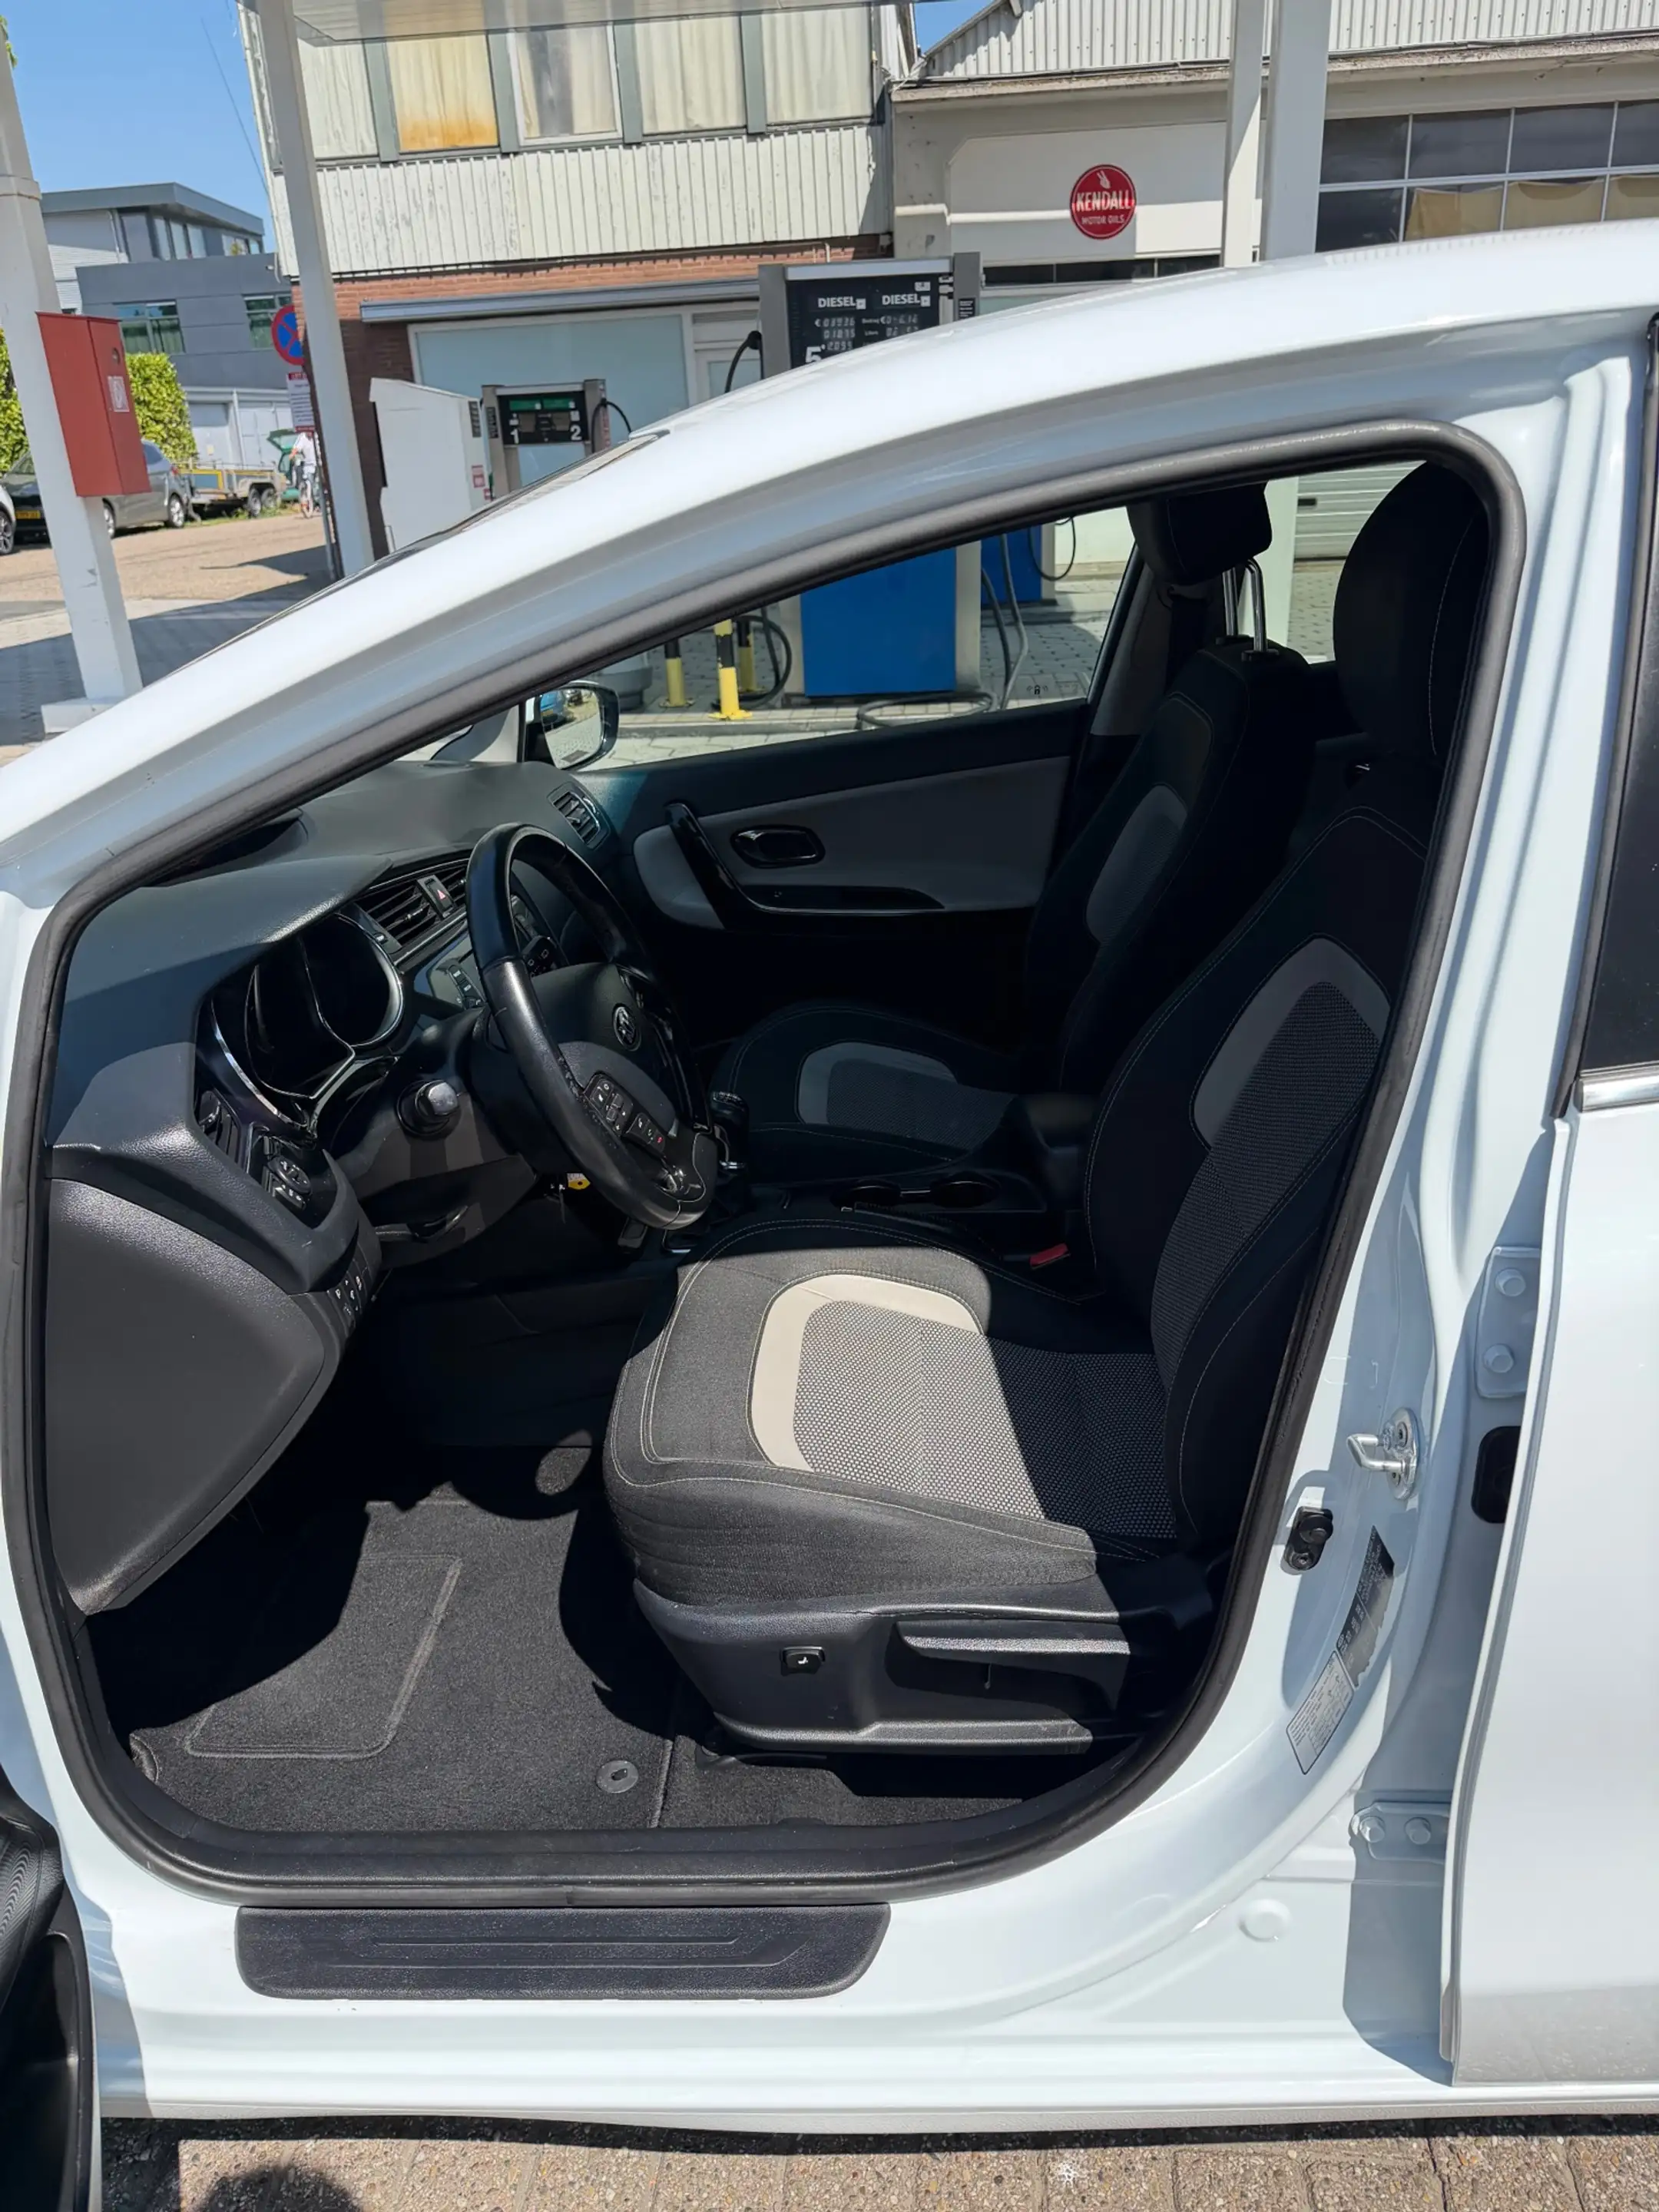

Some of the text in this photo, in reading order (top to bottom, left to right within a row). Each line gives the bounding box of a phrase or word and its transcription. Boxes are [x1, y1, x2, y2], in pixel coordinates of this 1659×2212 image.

[1076, 190, 1131, 212] KENDALL
[1081, 216, 1106, 225] MOTOR
[818, 296, 856, 308] DIESEL
[882, 293, 920, 305] DIESEL
[805, 346, 822, 363] 5
[510, 429, 519, 444] 1
[570, 425, 582, 441] 2
